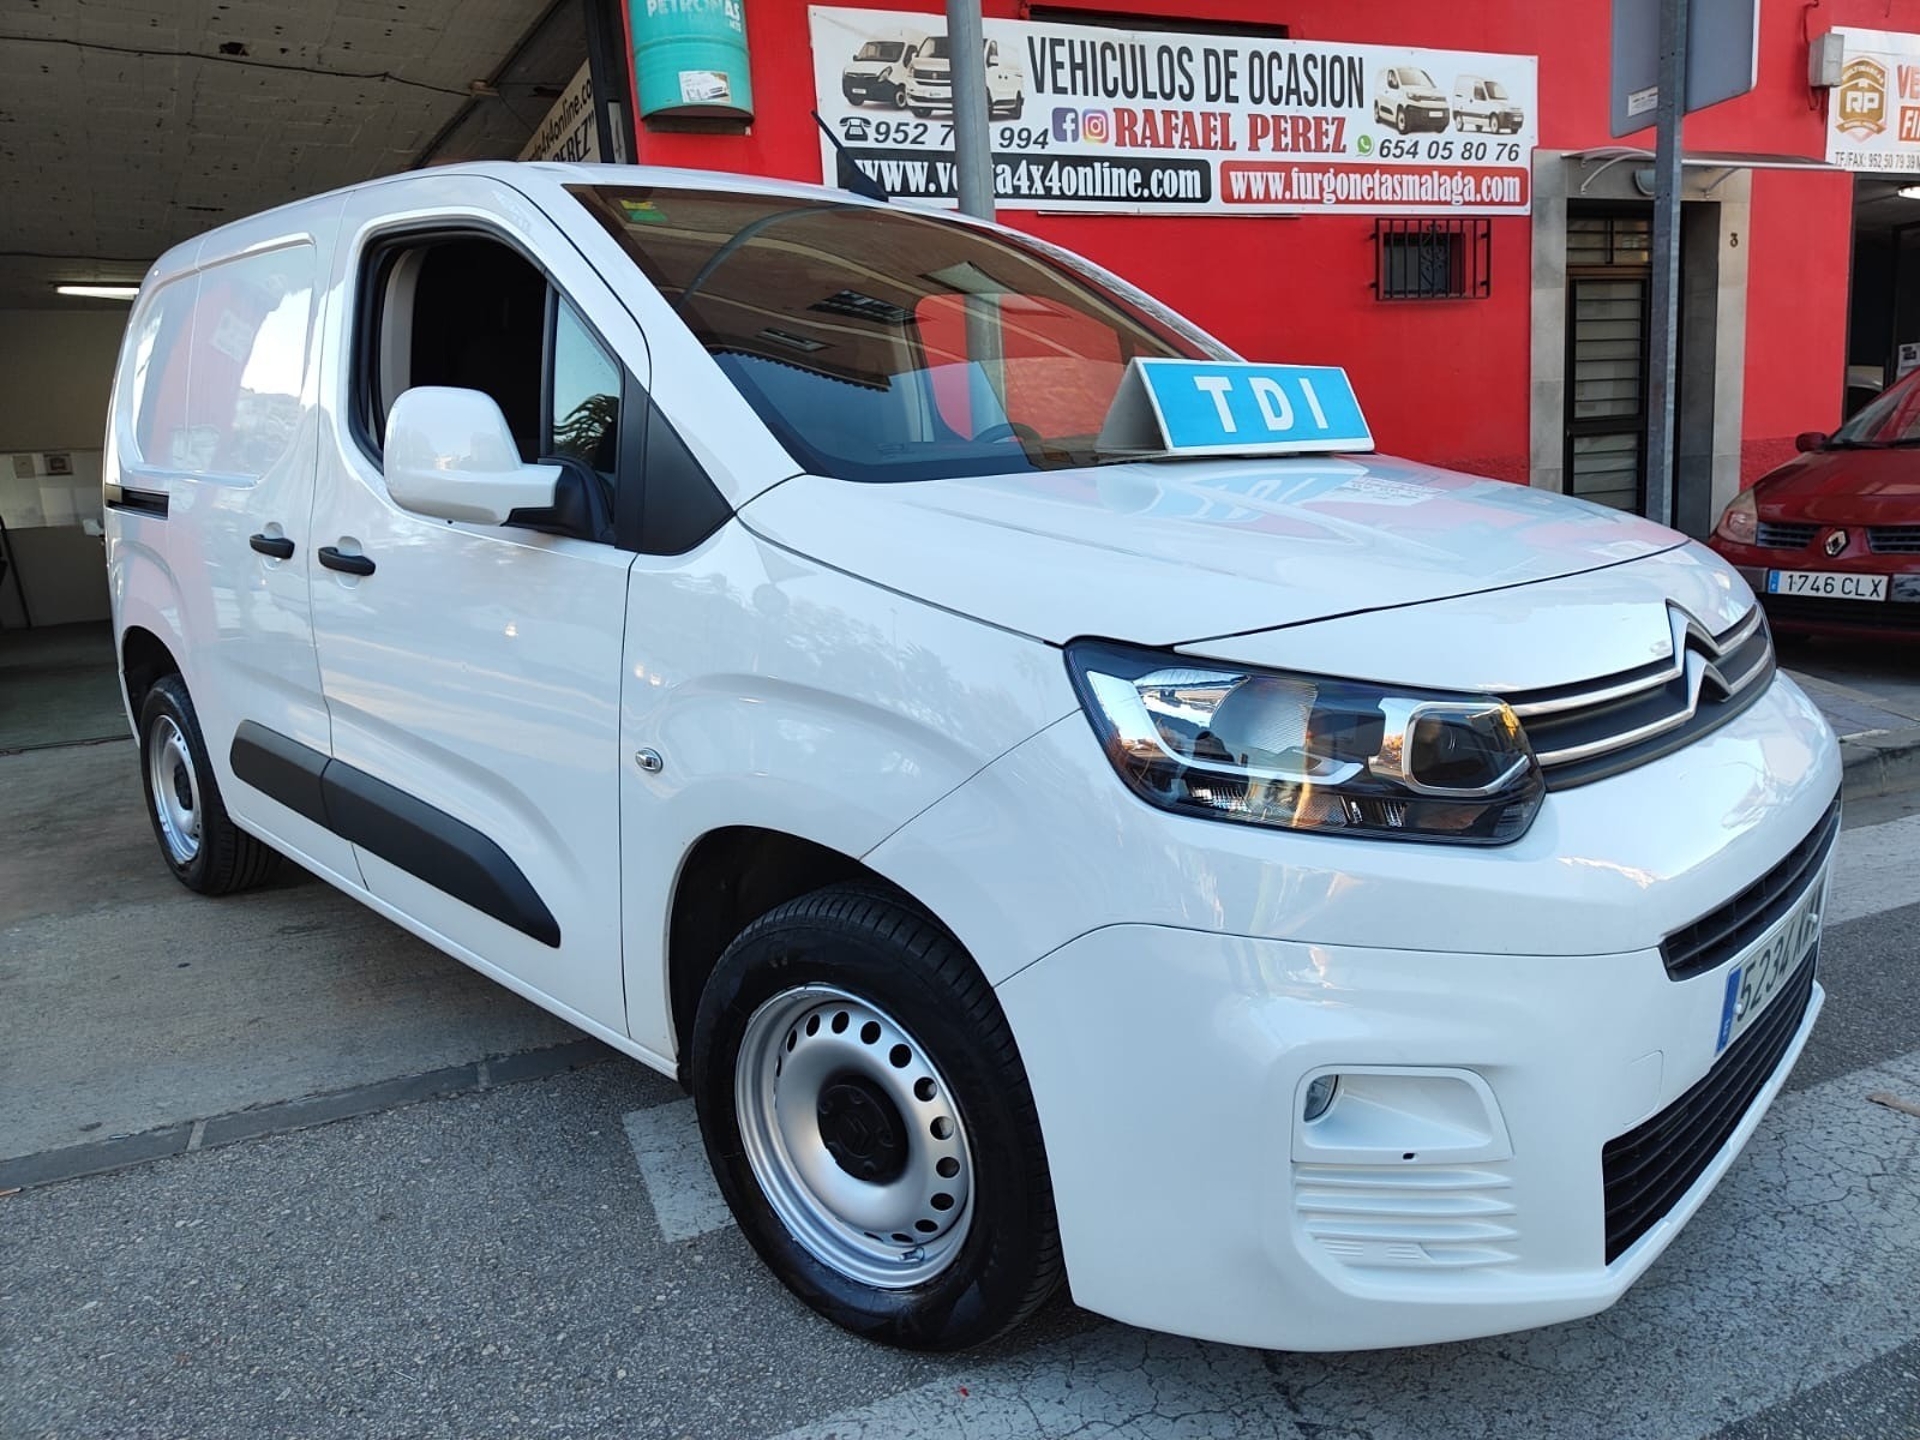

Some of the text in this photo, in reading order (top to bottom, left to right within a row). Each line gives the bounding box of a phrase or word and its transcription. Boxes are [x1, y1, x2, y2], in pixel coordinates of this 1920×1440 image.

[1027, 36, 1364, 109] VEHICULOS DE OCASION
[874, 121, 928, 145] 952
[1000, 127, 1049, 149] 994
[1113, 107, 1347, 153] RAFAEL PEREZ
[1379, 138, 1521, 162] 654 05 80 76
[1230, 168, 1521, 205] www.furgonetasmalaga.com
[1788, 574, 1883, 598] 1746 CLX
